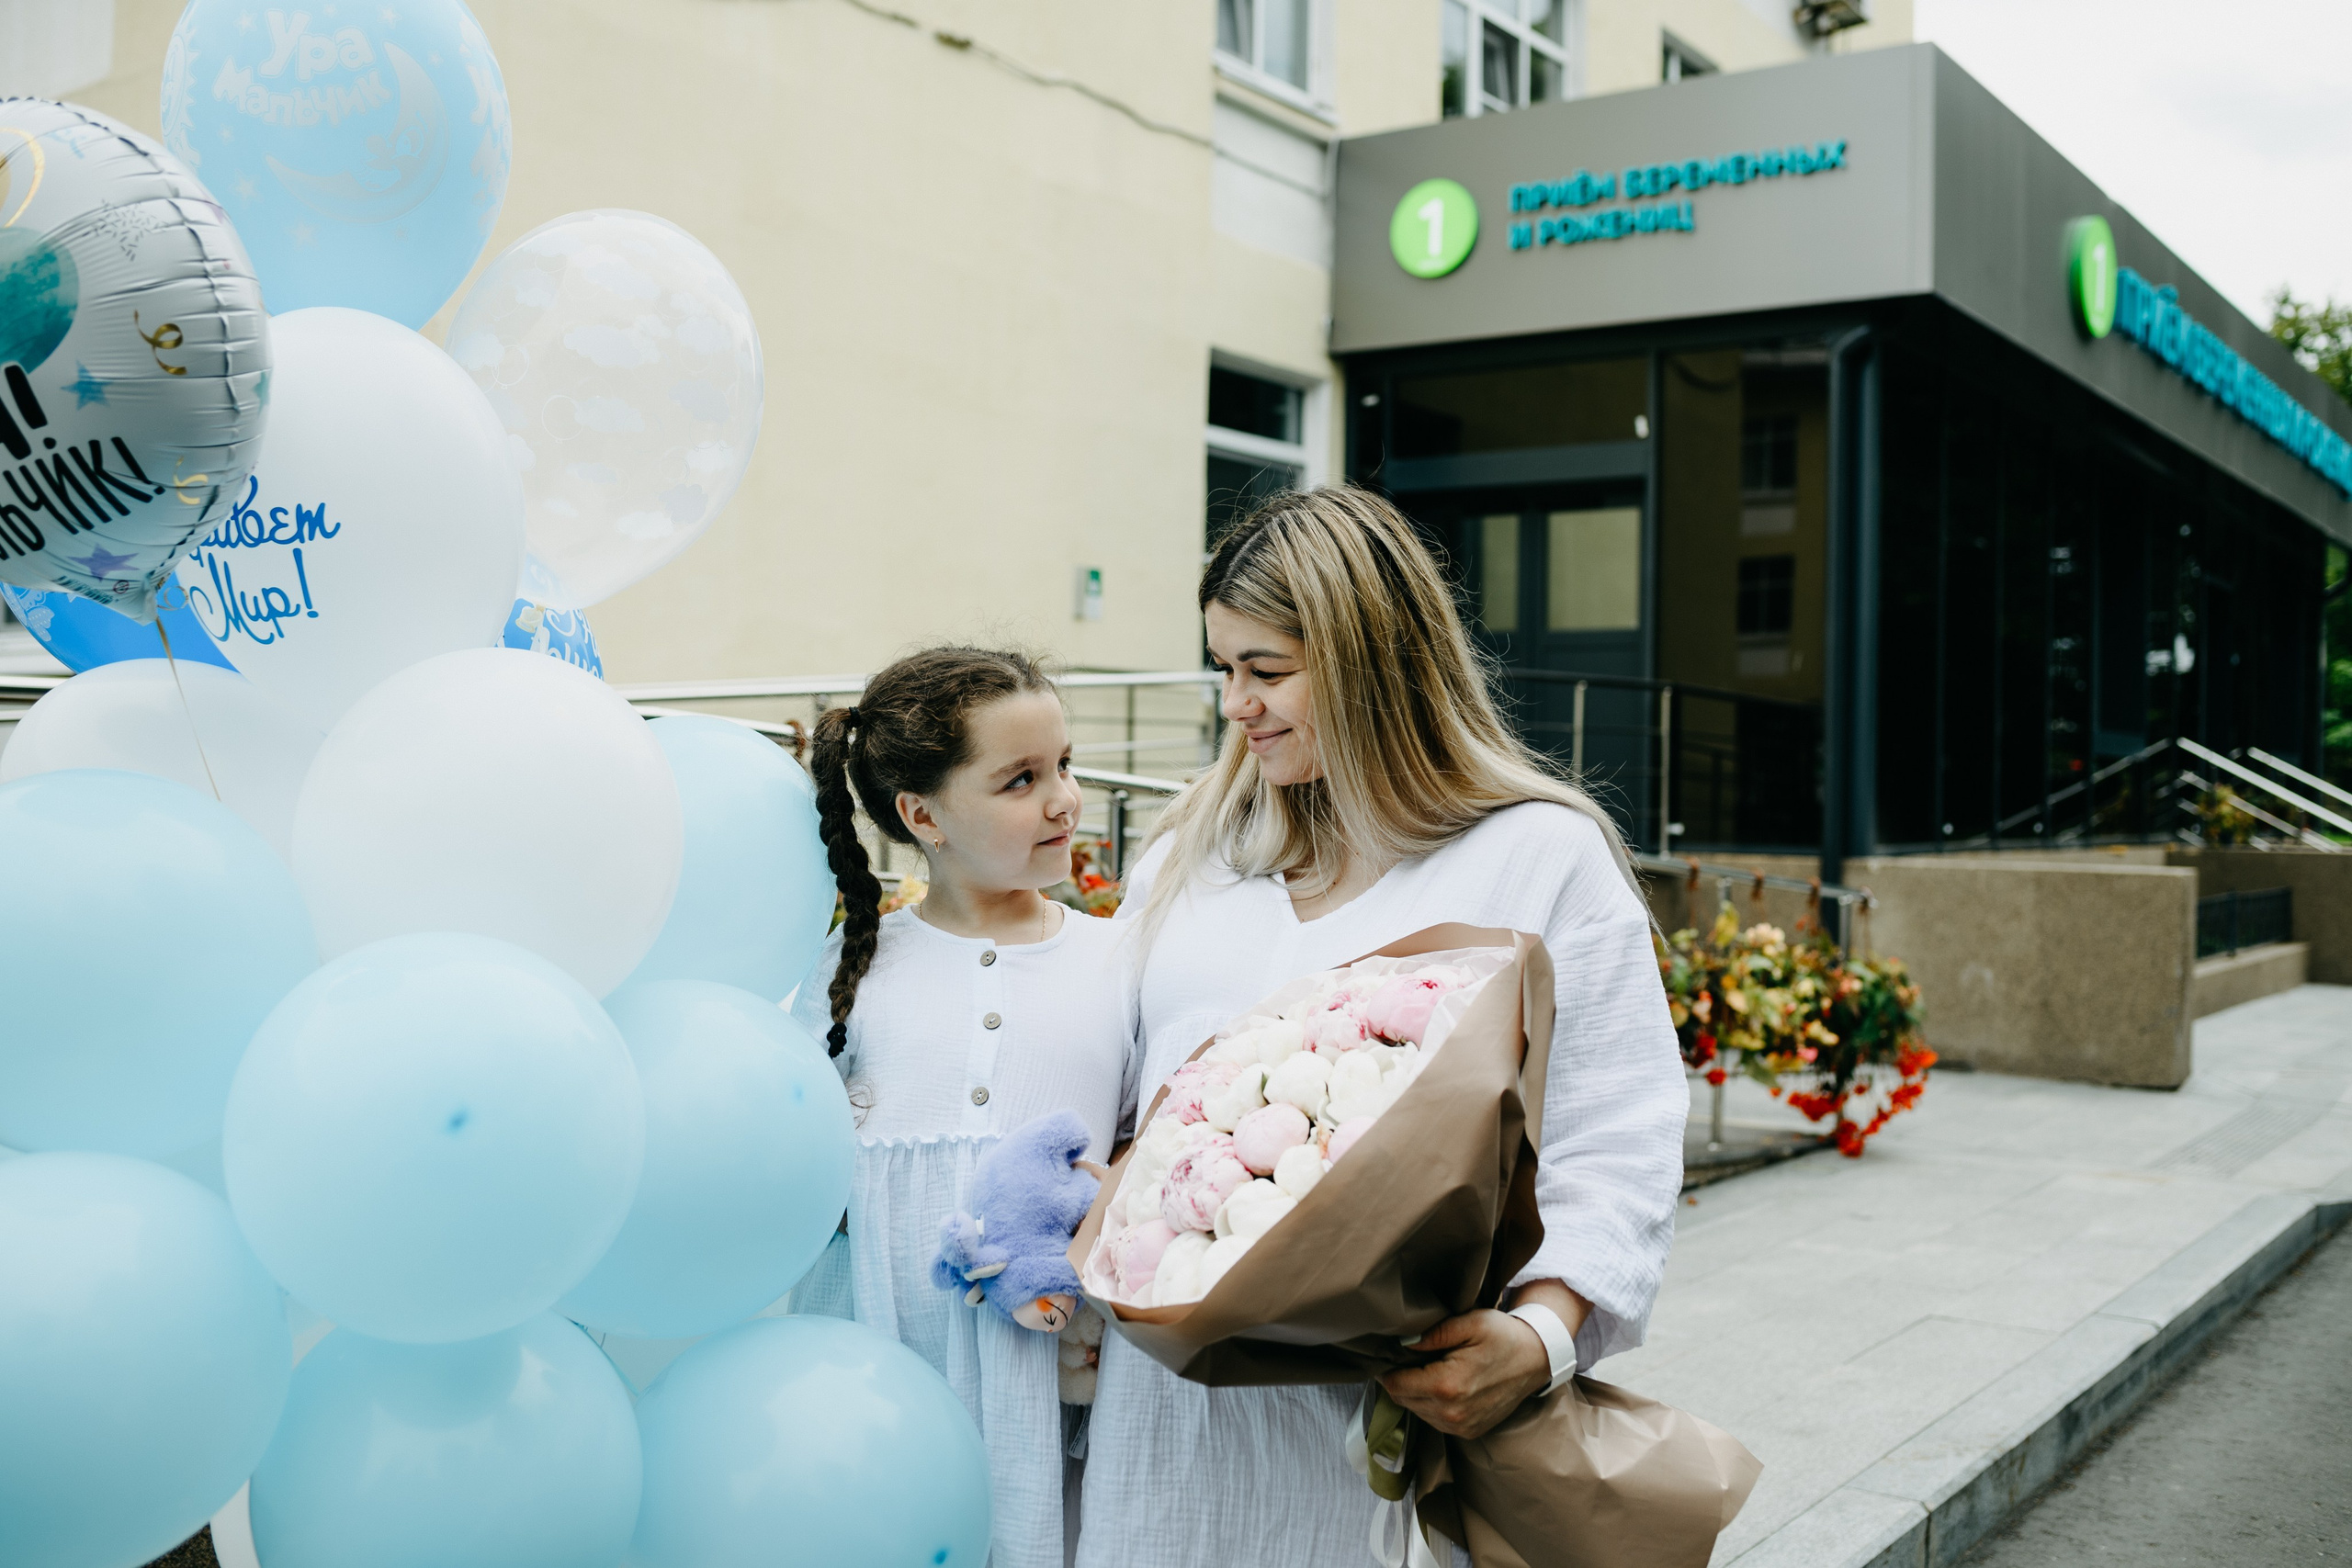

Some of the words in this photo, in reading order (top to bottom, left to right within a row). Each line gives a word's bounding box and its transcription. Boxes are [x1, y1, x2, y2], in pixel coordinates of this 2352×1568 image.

[258, 8, 376, 82] Ура
[1510, 167, 1616, 212] ПРИЁМ
[1622, 140, 1847, 198] БЕРЕМЕННЫХ
[1418, 197, 1443, 256] 1
[1508, 220, 1532, 250] И
[1537, 198, 1694, 245] РОЖЕНИЦ
[2093, 243, 2107, 312] 1
[189, 548, 319, 645] Мир!
